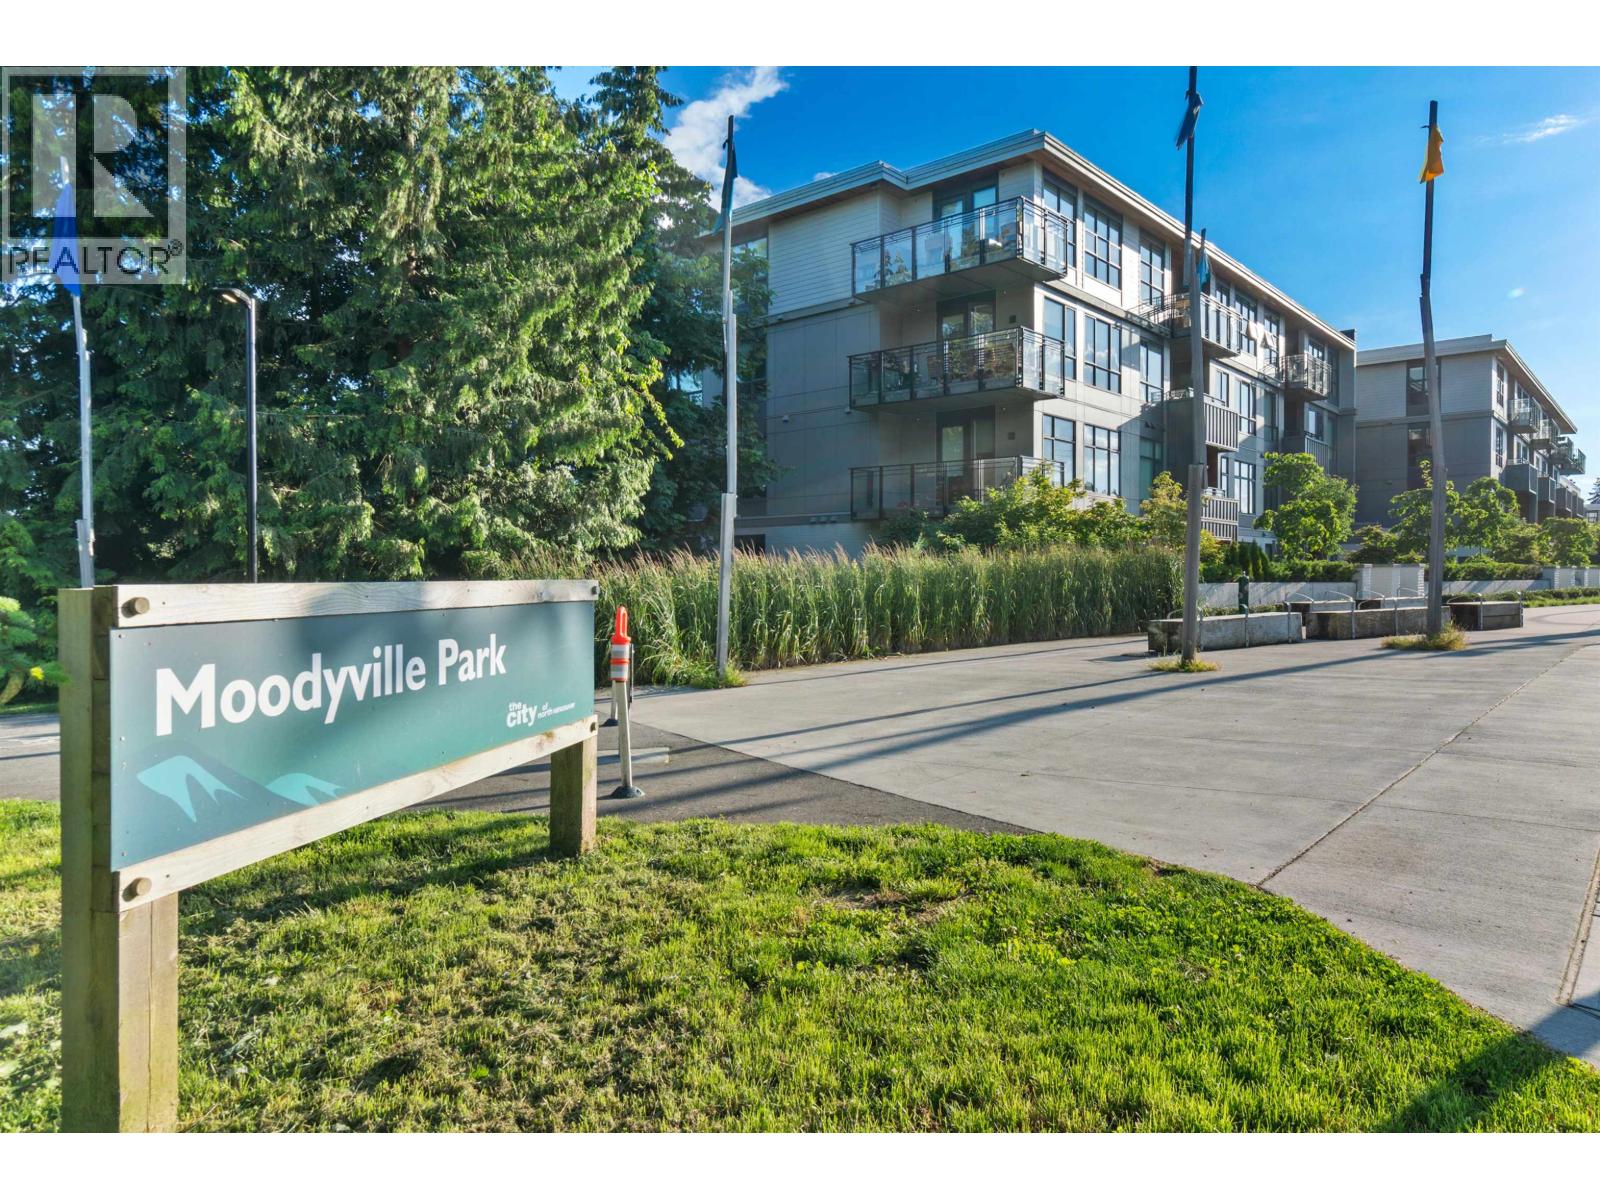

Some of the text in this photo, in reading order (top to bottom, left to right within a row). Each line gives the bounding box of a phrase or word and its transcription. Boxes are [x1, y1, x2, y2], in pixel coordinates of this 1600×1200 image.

[156, 633, 507, 736] Moodyville Park
[506, 704, 538, 728] city
[508, 702, 523, 712] the
